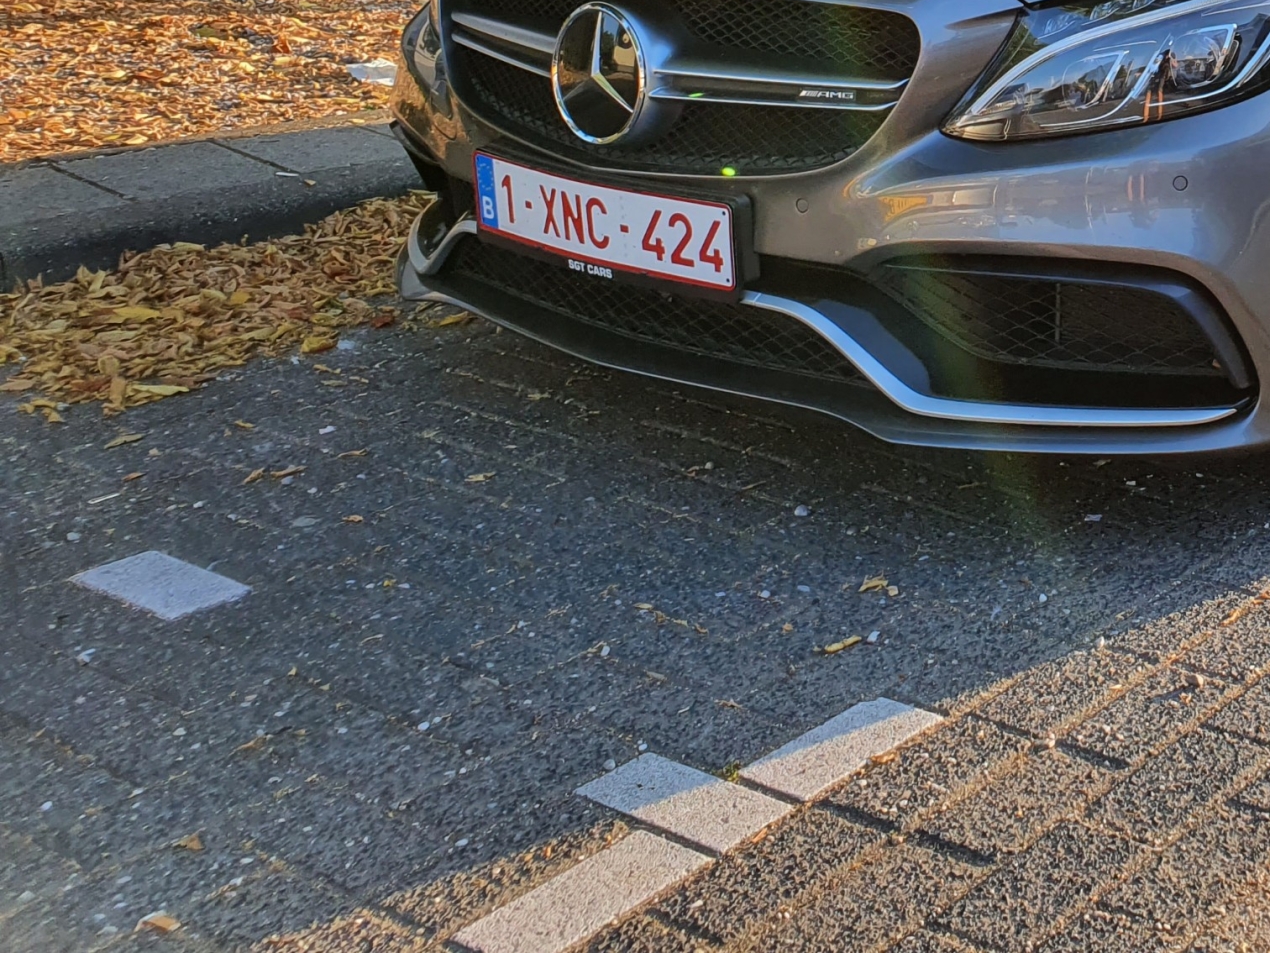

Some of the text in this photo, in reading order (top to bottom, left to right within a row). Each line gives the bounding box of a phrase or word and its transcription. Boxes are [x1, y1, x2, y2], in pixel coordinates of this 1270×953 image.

[817, 91, 854, 99] AMG
[483, 197, 494, 219] B
[501, 174, 724, 273] 1-XNC-424
[568, 259, 613, 279] SGT CARS
